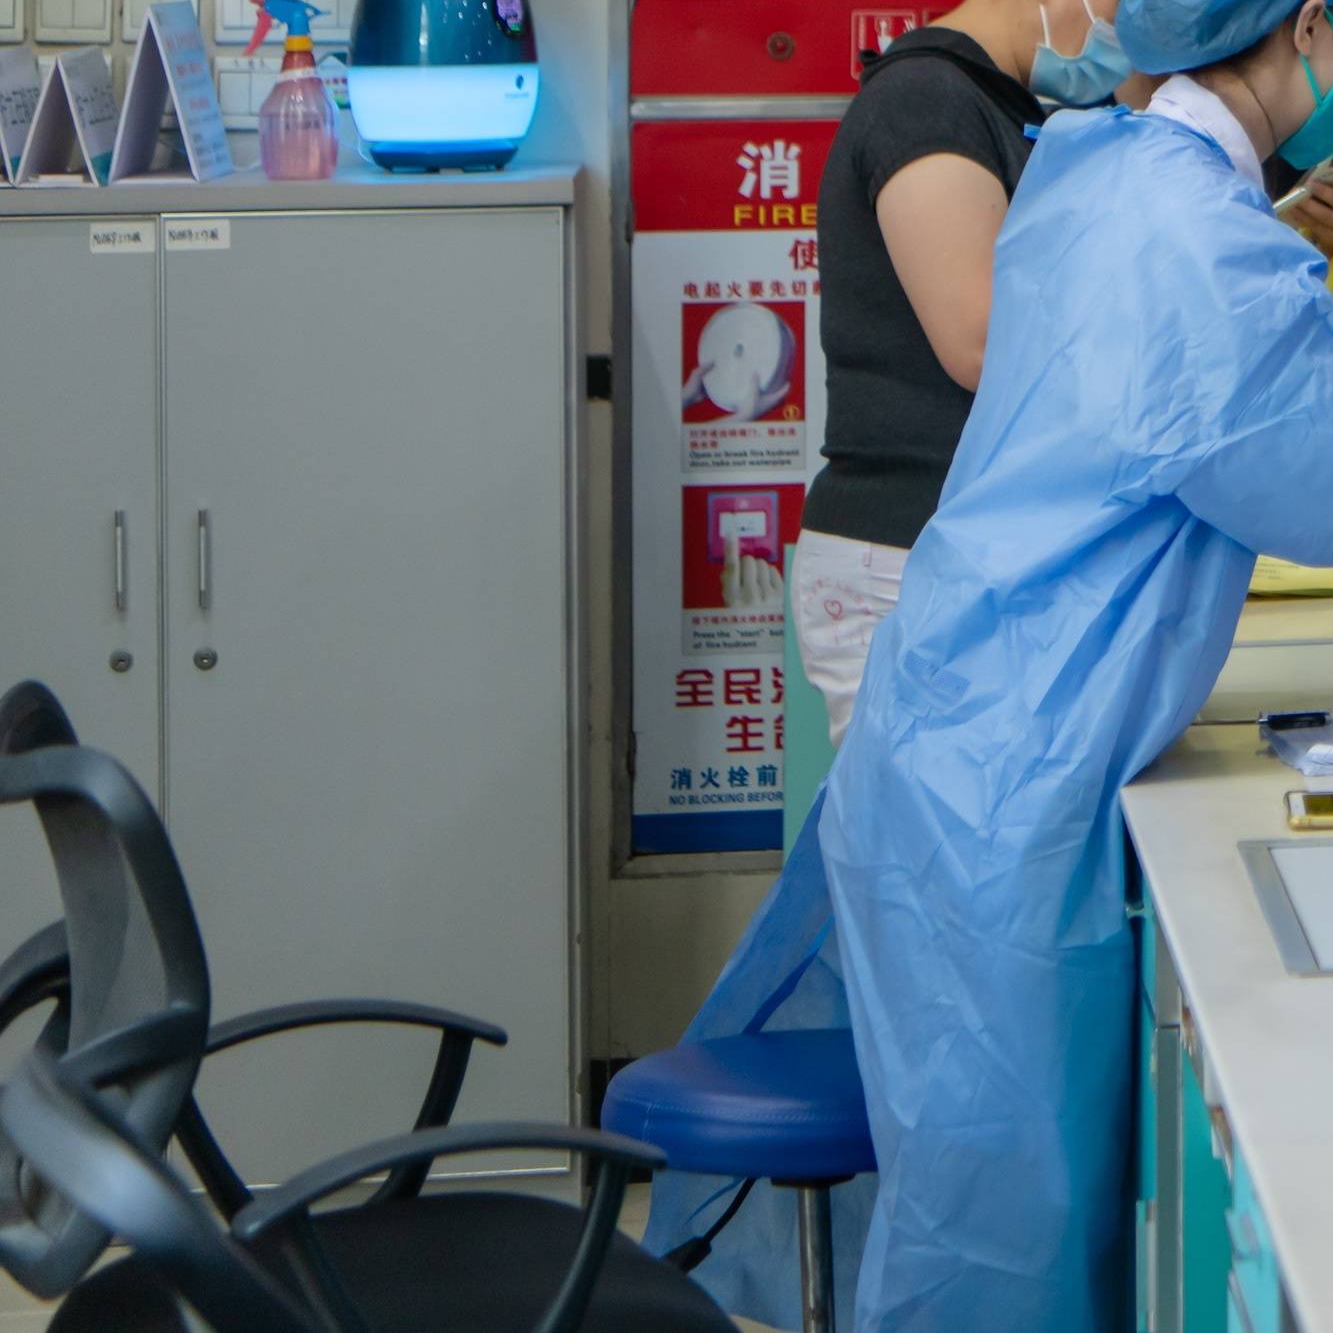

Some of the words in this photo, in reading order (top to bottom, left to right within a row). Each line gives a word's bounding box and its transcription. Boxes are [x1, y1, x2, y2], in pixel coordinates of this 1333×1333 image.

[736, 139, 801, 200] 消
[734, 204, 817, 226] FIRE
[671, 765, 778, 789] 消火栓前
[669, 795, 685, 805] NO
[688, 792, 744, 805] BLOCKING
